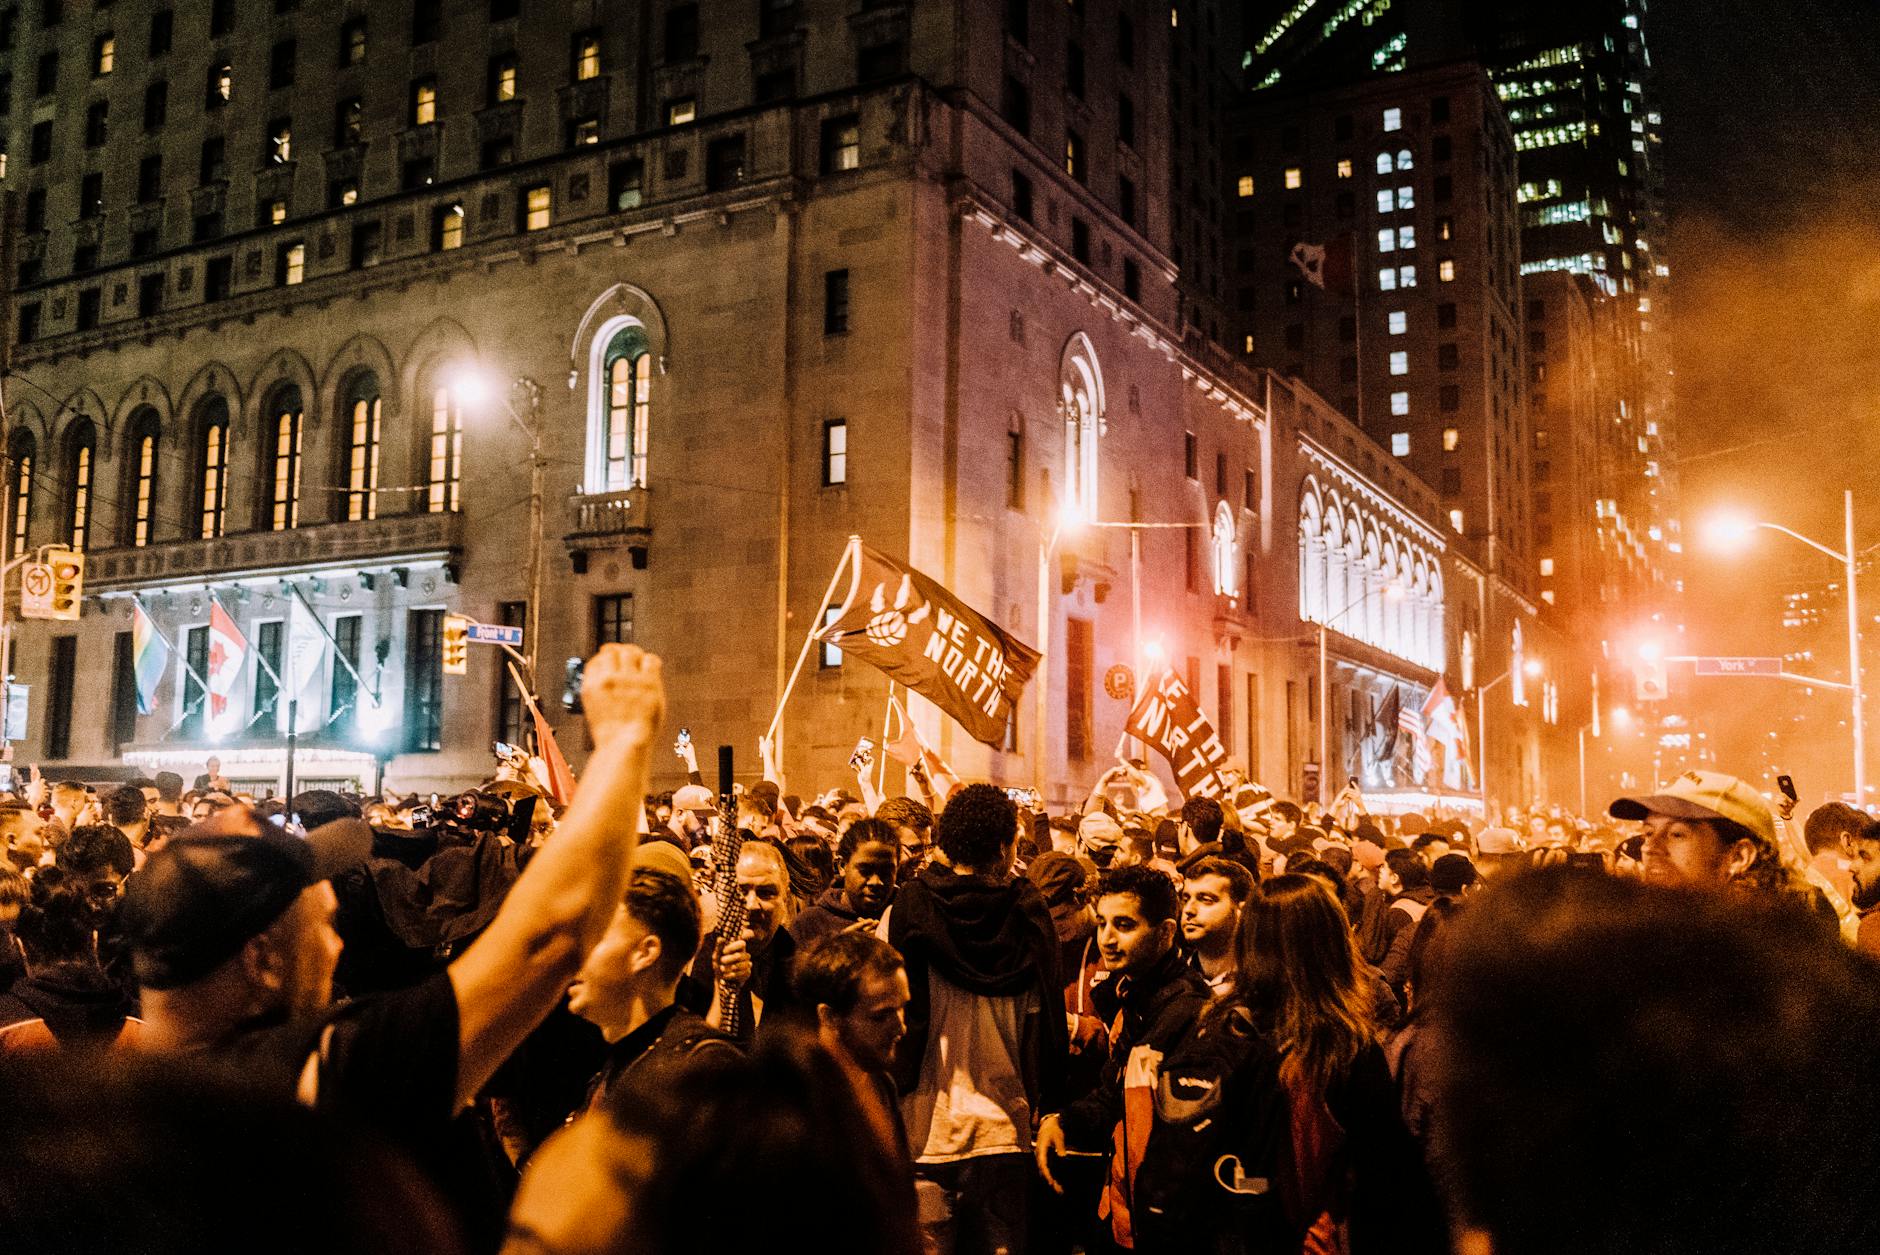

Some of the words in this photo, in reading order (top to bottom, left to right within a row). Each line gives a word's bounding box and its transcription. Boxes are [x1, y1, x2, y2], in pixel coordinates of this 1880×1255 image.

[923, 630, 1002, 718] NORTH
[936, 607, 970, 649] WE
[974, 634, 1014, 691] THE
[1718, 659, 1745, 671] York
[1113, 672, 1127, 689] P
